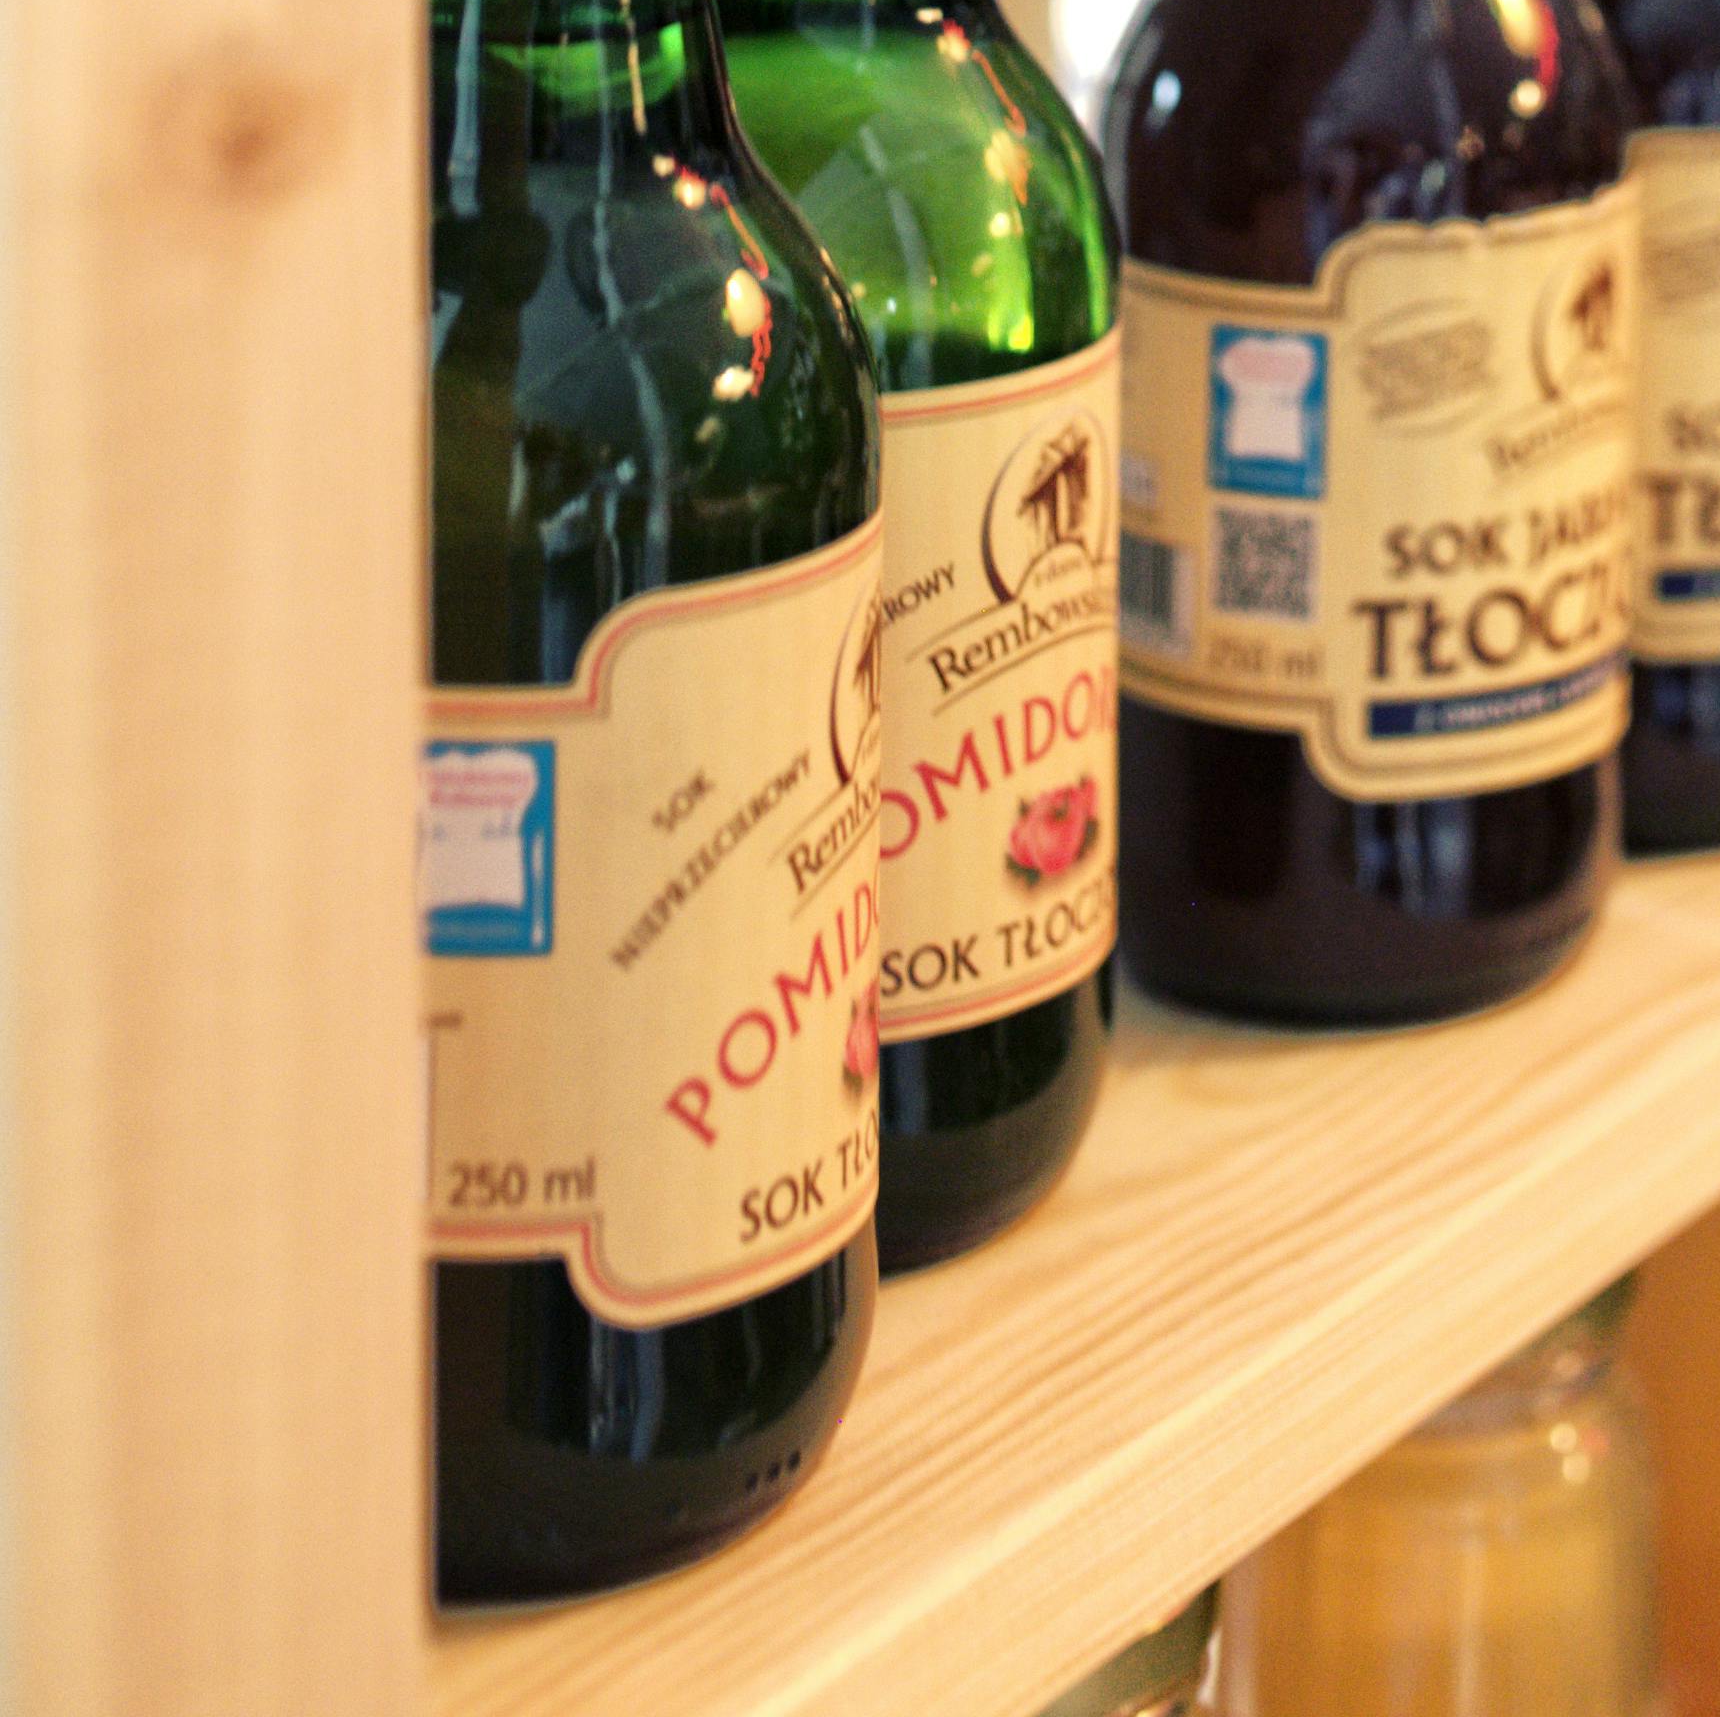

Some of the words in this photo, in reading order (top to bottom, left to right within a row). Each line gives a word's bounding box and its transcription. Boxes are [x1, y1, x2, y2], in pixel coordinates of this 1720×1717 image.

[1384, 518, 1508, 579] SOK
[651, 767, 716, 836] SOK
[880, 934, 980, 999] SOK
[447, 1163, 530, 1208] 250
[542, 1154, 597, 1204] ml
[739, 1157, 825, 1245] SOK
